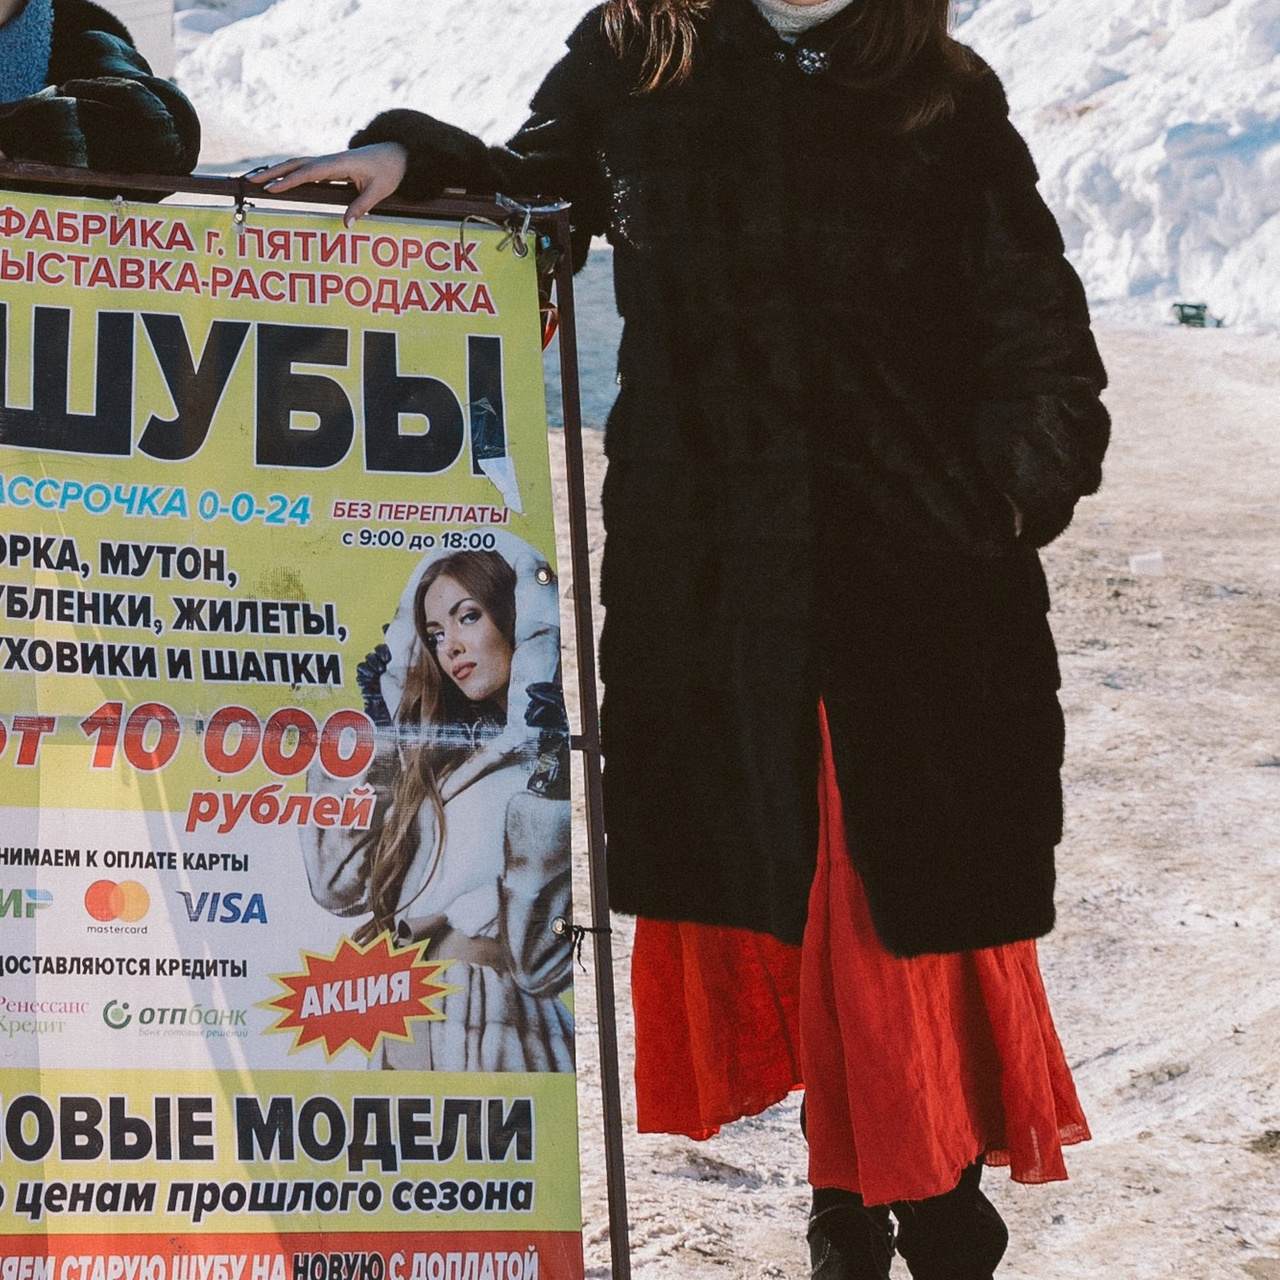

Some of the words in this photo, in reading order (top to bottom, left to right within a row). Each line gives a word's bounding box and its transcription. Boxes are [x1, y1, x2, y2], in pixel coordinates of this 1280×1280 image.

[206, 230, 224, 257] г.
[237, 228, 479, 273] ПЯТИГОРСК
[198, 490, 312, 526] 0-0-24
[333, 501, 372, 519] БЕЗ
[377, 503, 509, 524] ПЕРЕПЛАТЫ
[342, 532, 354, 545] с
[359, 529, 405, 548] 9:00
[409, 534, 435, 550] до
[441, 532, 496, 550] 18:00
[99, 542, 237, 587] МУТОН,
[172, 596, 347, 642] ЖИЛЕТЫ,
[166, 646, 193, 680] И
[202, 648, 343, 686] ШАПКИ
[80, 701, 181, 771] 10
[203, 705, 376, 778] 000
[184, 784, 379, 835] рублей
[86, 849, 98, 868] К
[103, 850, 177, 871] ОПЛАТЕ
[182, 852, 249, 873] КАРТЫ
[175, 890, 268, 925] VISA
[87, 925, 148, 935] mastercard
[155, 957, 248, 980] КРЕДИТЫ
[300, 970, 411, 1020] АКЦИЯ
[235, 1096, 534, 1173] МОДЕЛИ
[14, 1182, 158, 1221] ценам
[166, 1181, 383, 1223] прошлого
[391, 1180, 534, 1213] сезона
[59, 1254, 167, 1280] СТАРУЮ
[170, 1254, 248, 1280] ШУБУ
[250, 1253, 287, 1280] НА
[292, 1252, 385, 1280] НОВУЮ
[388, 1252, 406, 1280] С
[409, 1244, 539, 1280] ДОПЛАТОЙ
